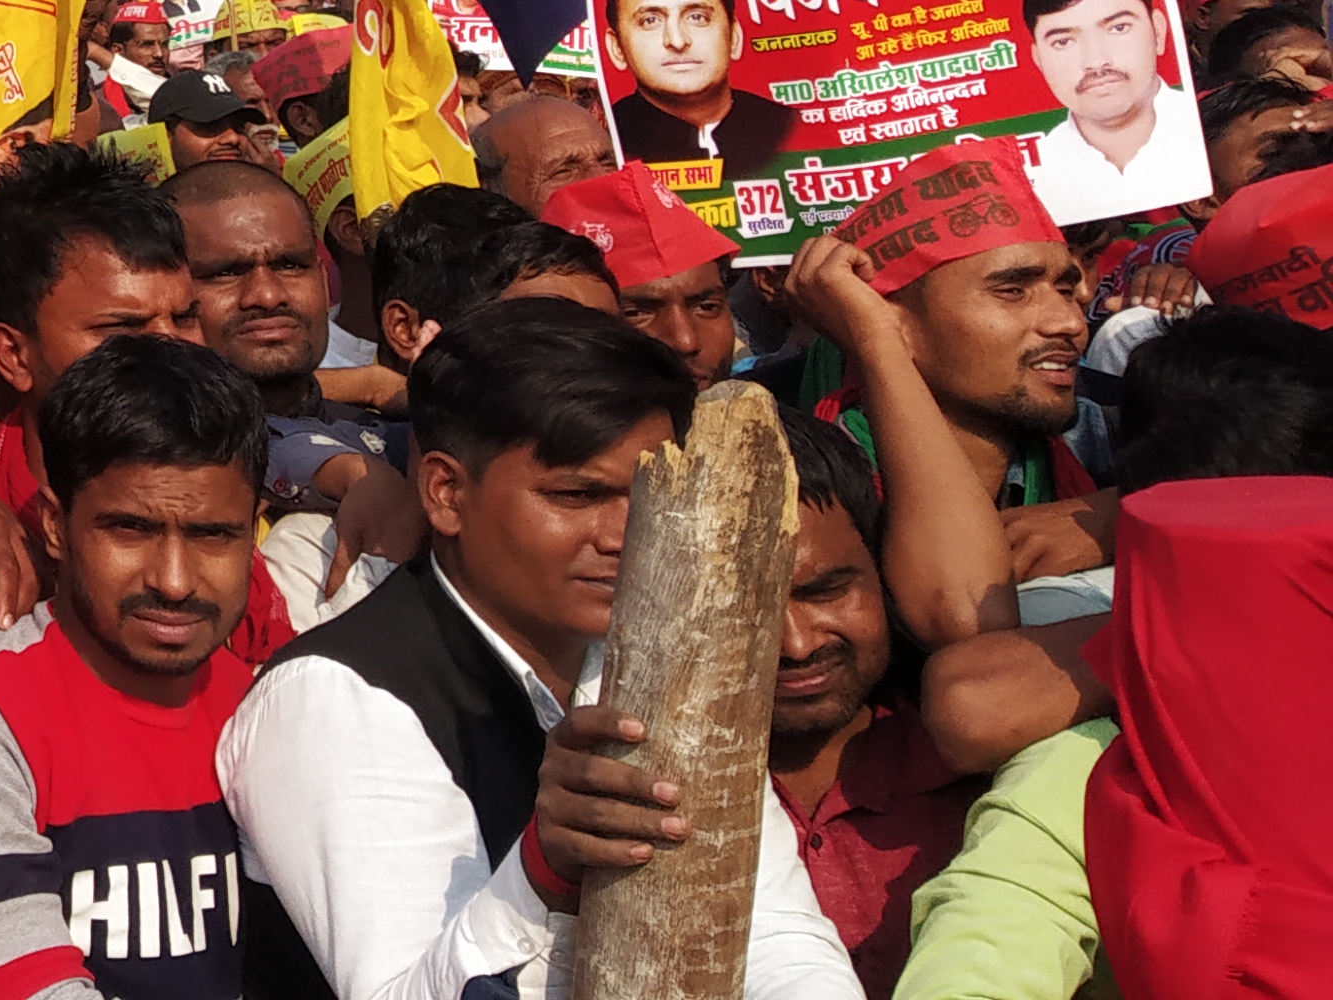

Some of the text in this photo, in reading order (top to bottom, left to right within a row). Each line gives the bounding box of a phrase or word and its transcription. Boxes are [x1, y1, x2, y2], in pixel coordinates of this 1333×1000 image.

[751, 28, 838, 52] जननायक
[850, 20, 872, 41] यू.
[874, 13, 889, 33] पी
[890, 11, 911, 29] का
[911, 6, 928, 26] है
[855, 43, 874, 62] आ
[876, 36, 900, 56] रहे
[916, 28, 948, 50] फिर
[950, 16, 1011, 41] अखिलेश
[771, 40, 1017, 105] मा0 अखिलेश यादव जी
[800, 79, 987, 124] का हार्दिक अभिनन्दन
[838, 105, 960, 146] एवं स्वागत है
[685, 163, 713, 185] सभा
[914, 159, 1000, 202] यादव
[737, 184, 784, 216] 372
[746, 218, 785, 236] सुरक्षित
